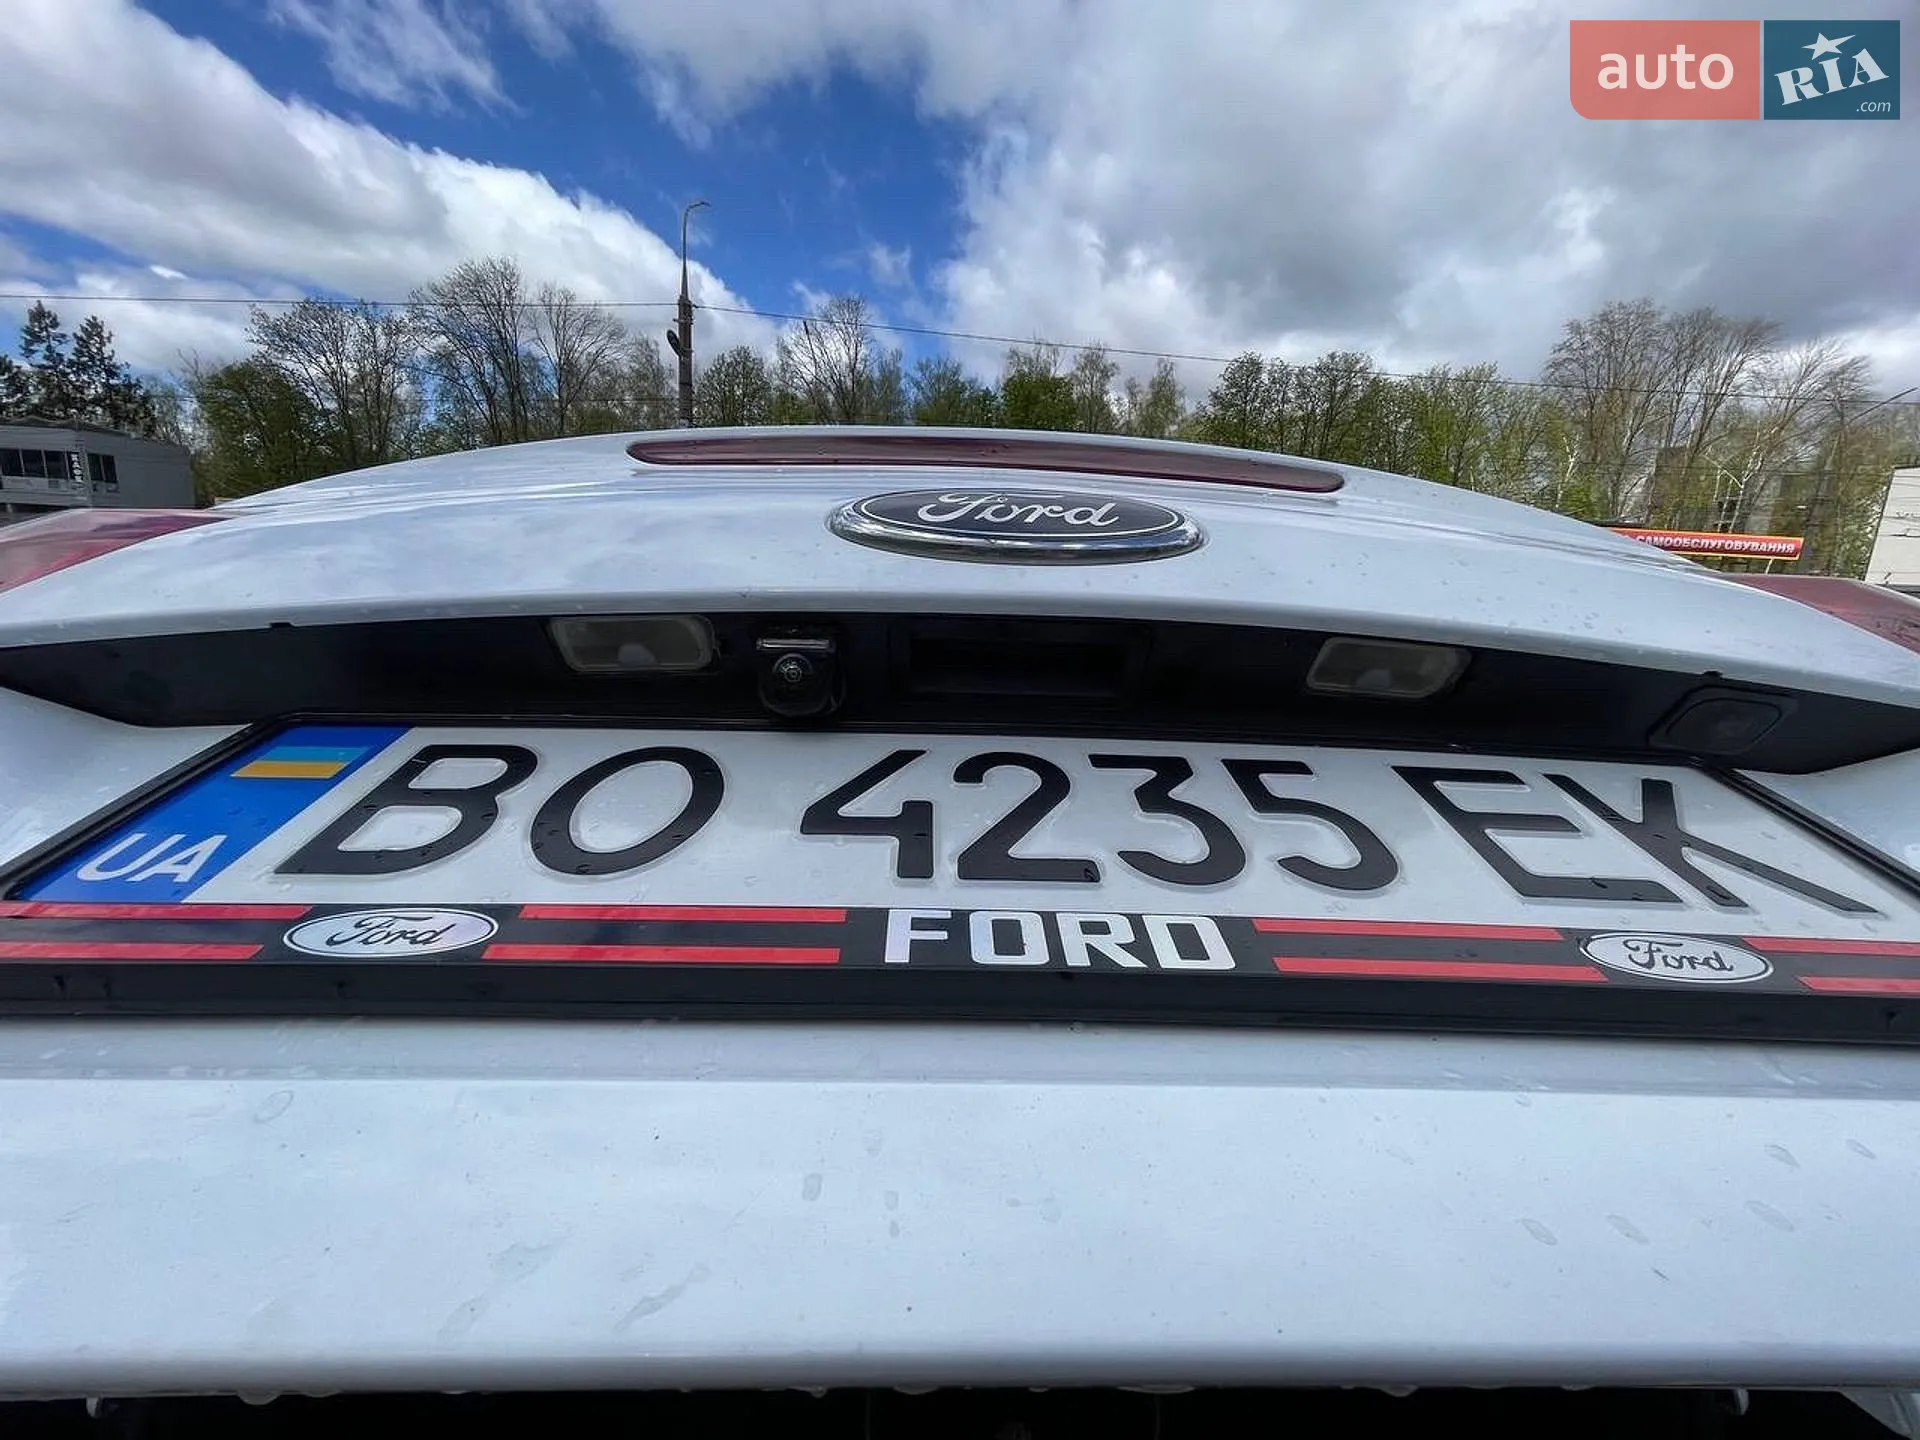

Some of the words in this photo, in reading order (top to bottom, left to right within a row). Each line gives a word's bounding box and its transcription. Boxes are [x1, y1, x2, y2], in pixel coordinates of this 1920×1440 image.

[917, 493, 1118, 527] Ford
[273, 744, 726, 876] BO
[800, 749, 1400, 890] 4235
[1390, 766, 1880, 913] EK
[76, 832, 227, 883] UA
[326, 915, 458, 948] Ford
[884, 908, 1236, 971] FORD
[1622, 938, 1734, 972] Ford
